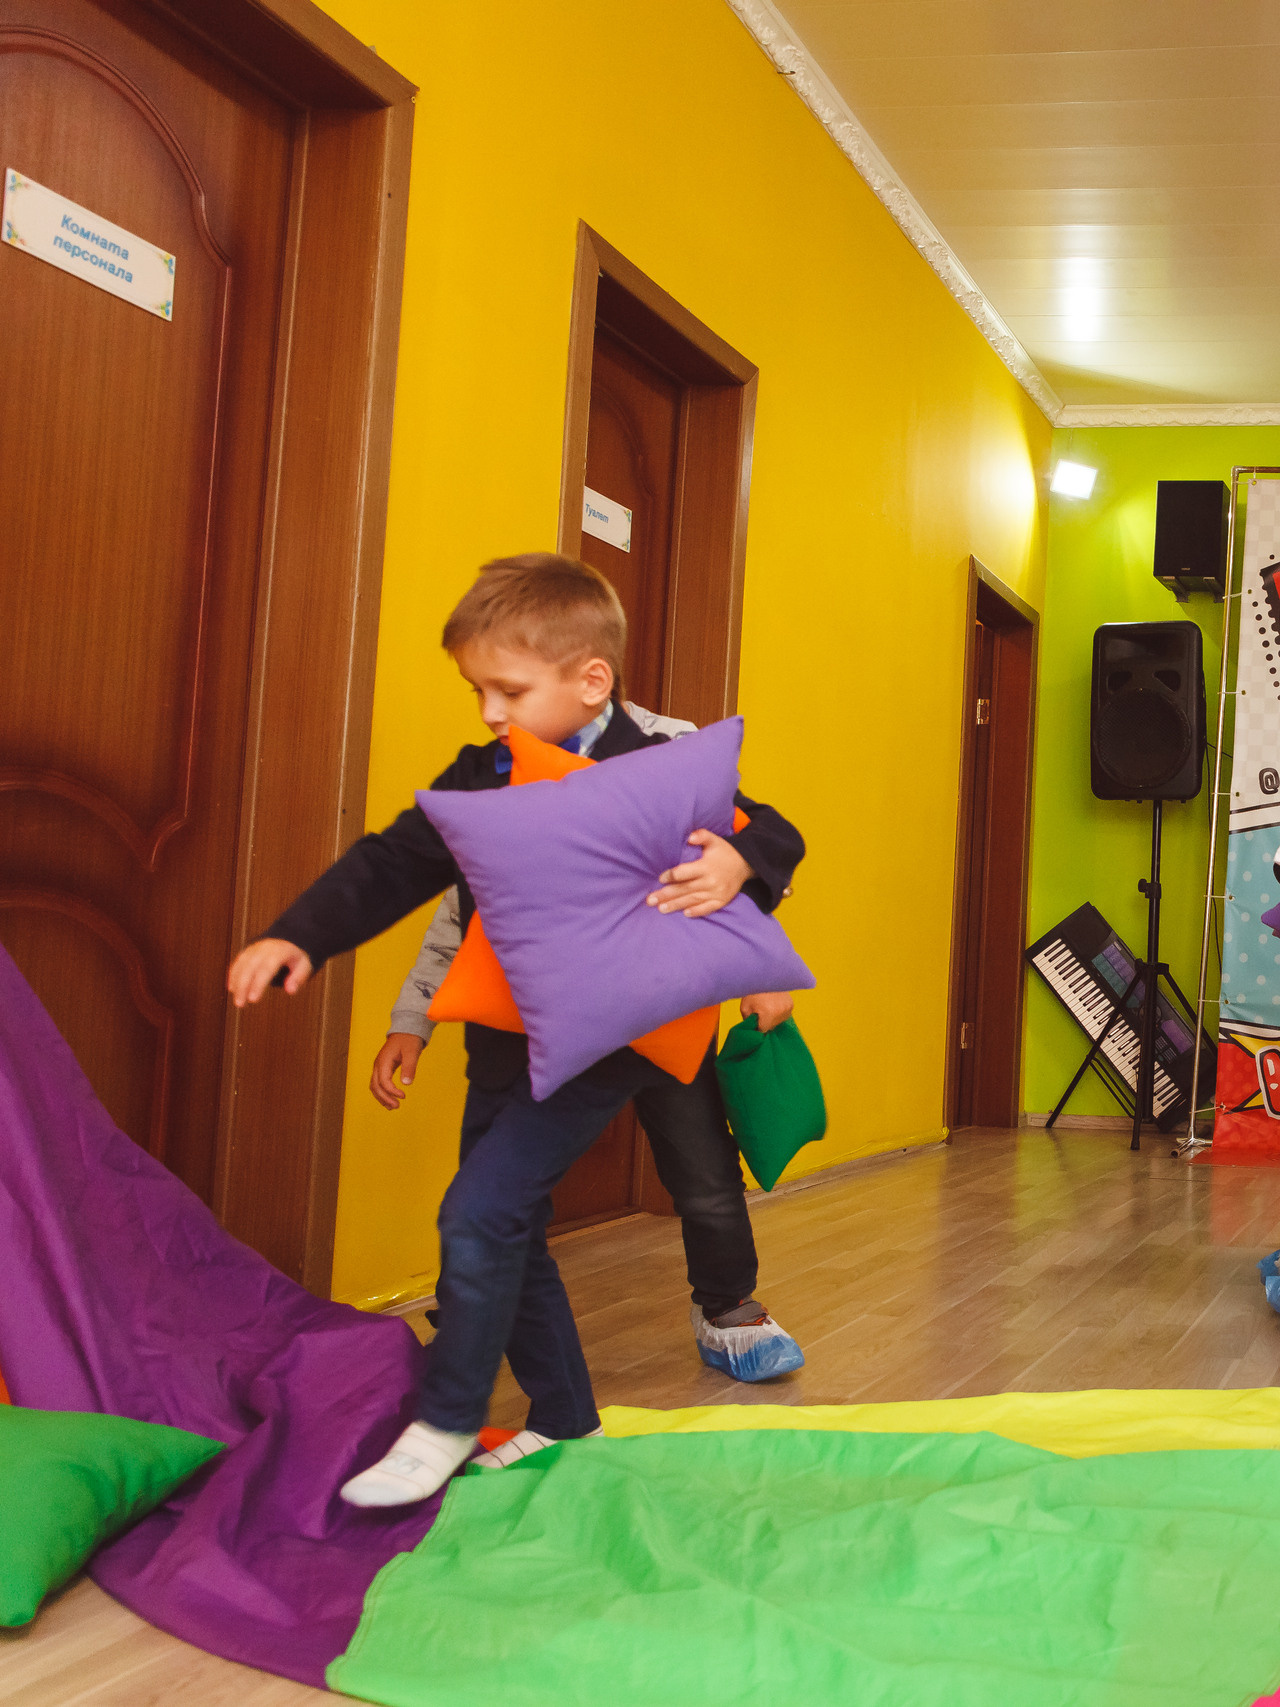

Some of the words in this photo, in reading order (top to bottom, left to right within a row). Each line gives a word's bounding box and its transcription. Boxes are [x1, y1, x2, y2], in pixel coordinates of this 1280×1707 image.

[53, 234, 133, 283] персонала
[61, 214, 130, 261] Комната
[585, 503, 609, 524] Туалет
